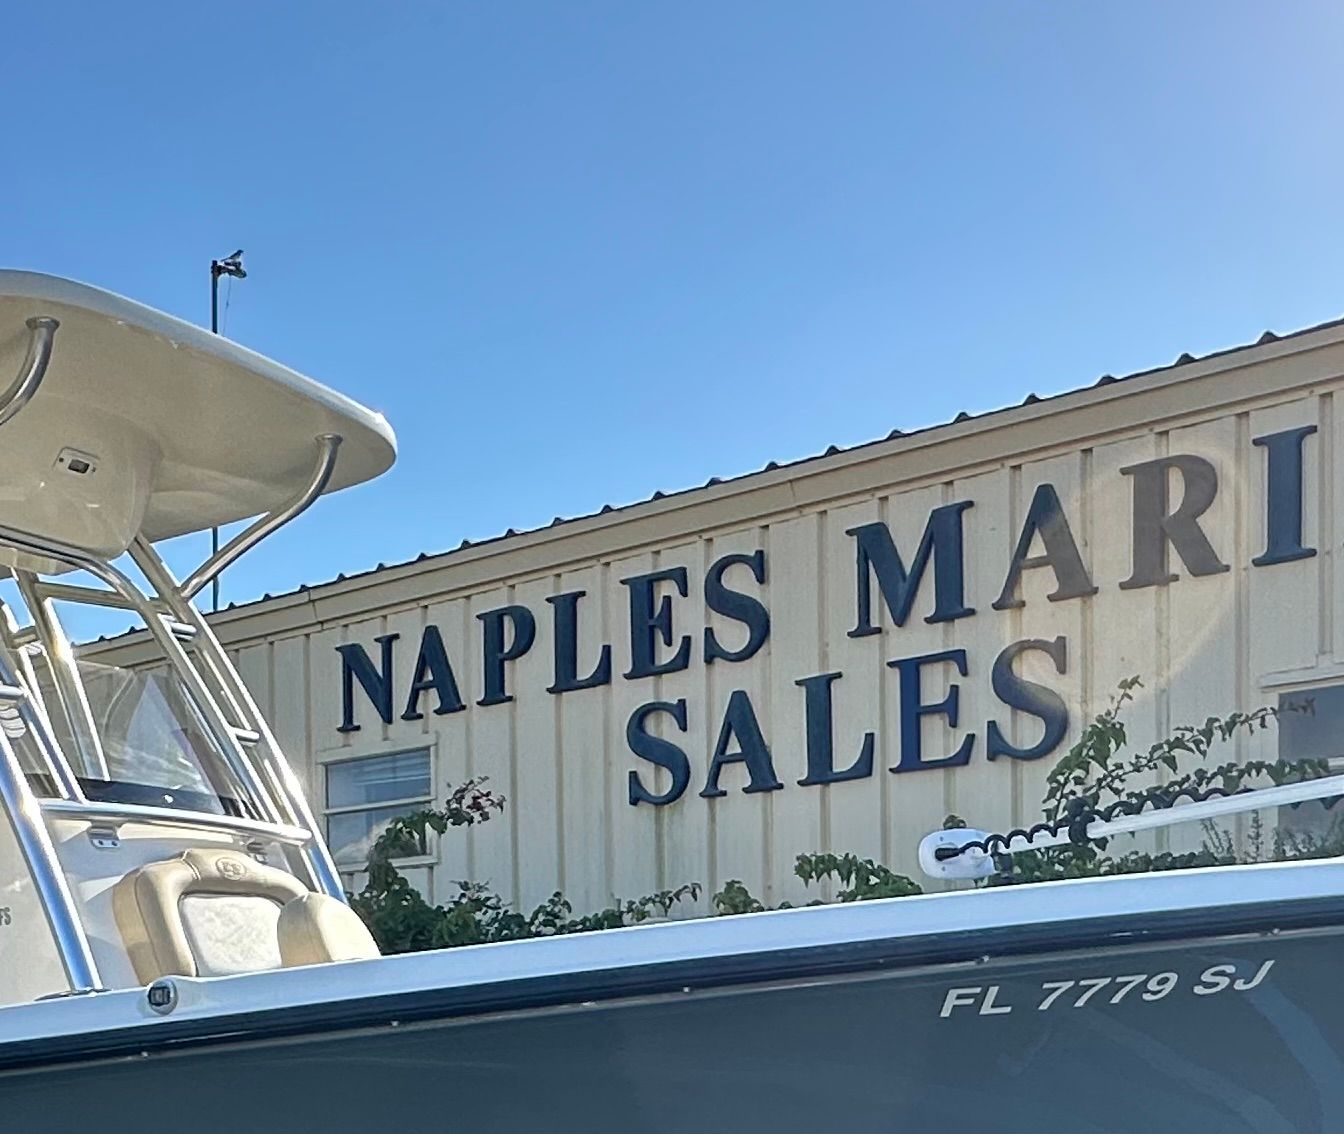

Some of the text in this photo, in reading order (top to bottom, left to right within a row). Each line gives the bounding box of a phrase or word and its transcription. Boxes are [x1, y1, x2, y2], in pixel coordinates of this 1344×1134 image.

[335, 549, 771, 733] NAPLES
[626, 636, 1070, 806] SALES
[0, 907, 11, 926] FS
[939, 959, 1276, 1018] FL 7779 SJ
